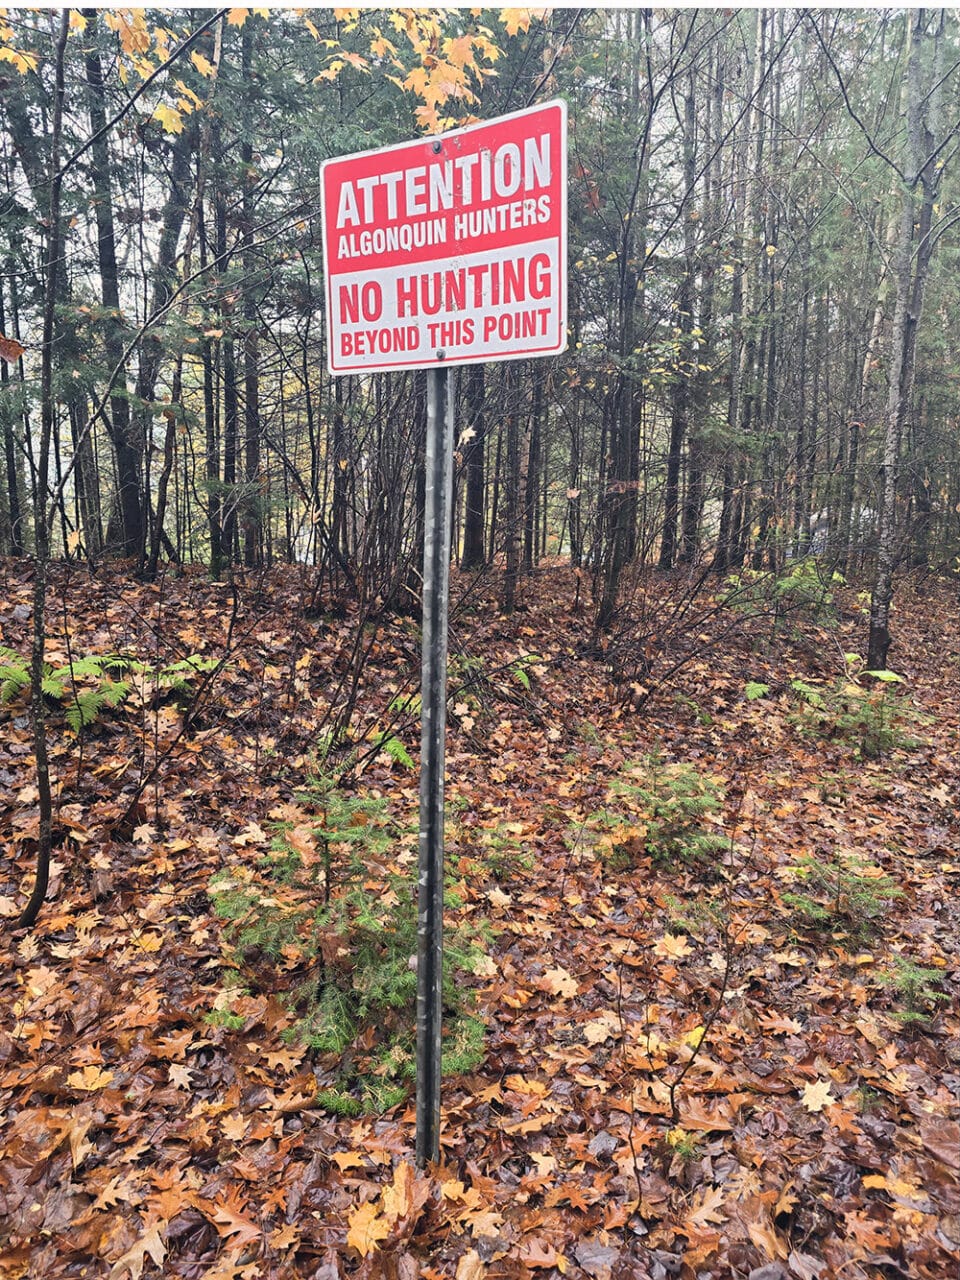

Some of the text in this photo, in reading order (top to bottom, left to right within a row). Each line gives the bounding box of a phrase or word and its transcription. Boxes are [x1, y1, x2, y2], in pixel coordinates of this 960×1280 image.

[336, 132, 551, 229] ATTENTION
[337, 194, 551, 260] ALGONQUIN HUNTERS
[339, 252, 551, 325] NO HUNTING
[340, 308, 551, 357] BEYOND THIS POINT
